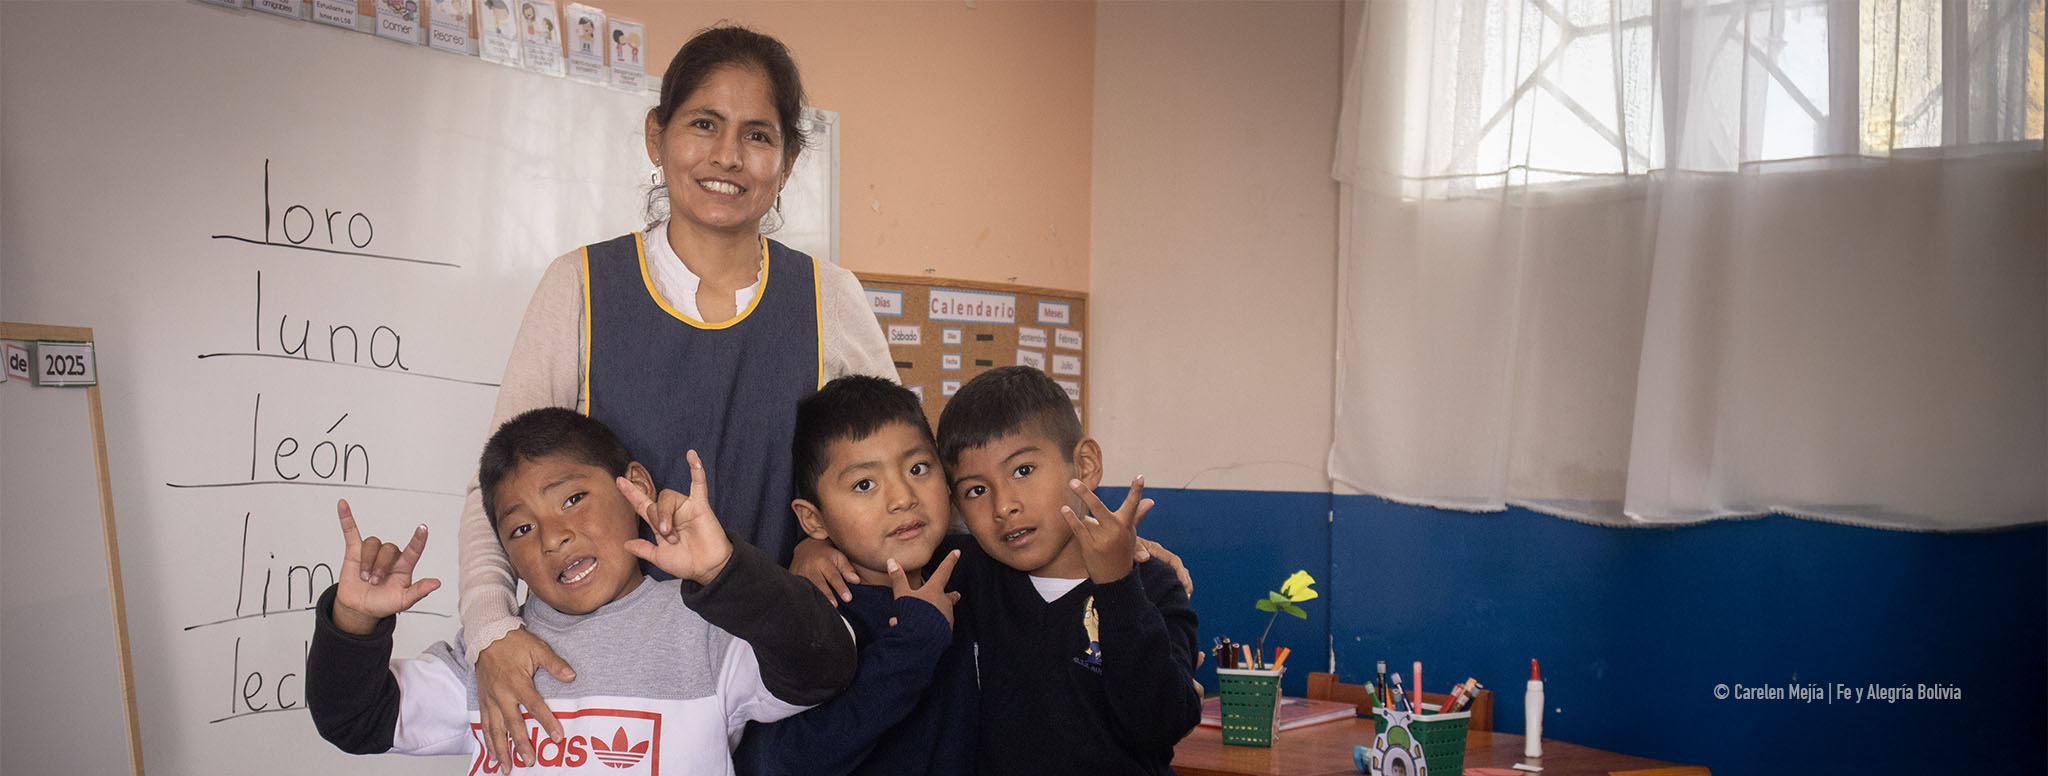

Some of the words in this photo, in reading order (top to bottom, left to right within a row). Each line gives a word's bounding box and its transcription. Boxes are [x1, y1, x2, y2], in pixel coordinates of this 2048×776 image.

[383, 19, 412, 34] Comer
[433, 30, 464, 46] Recreo
[264, 158, 373, 249] loro
[874, 296, 891, 308] Días
[931, 298, 1014, 319] Calendario
[256, 270, 409, 371] luna
[1043, 307, 1064, 319] Meses
[891, 329, 918, 342] Sábado
[1058, 333, 1079, 345] Febrero
[9, 353, 27, 372] de
[45, 354, 86, 376] 2025
[251, 393, 369, 485] león
